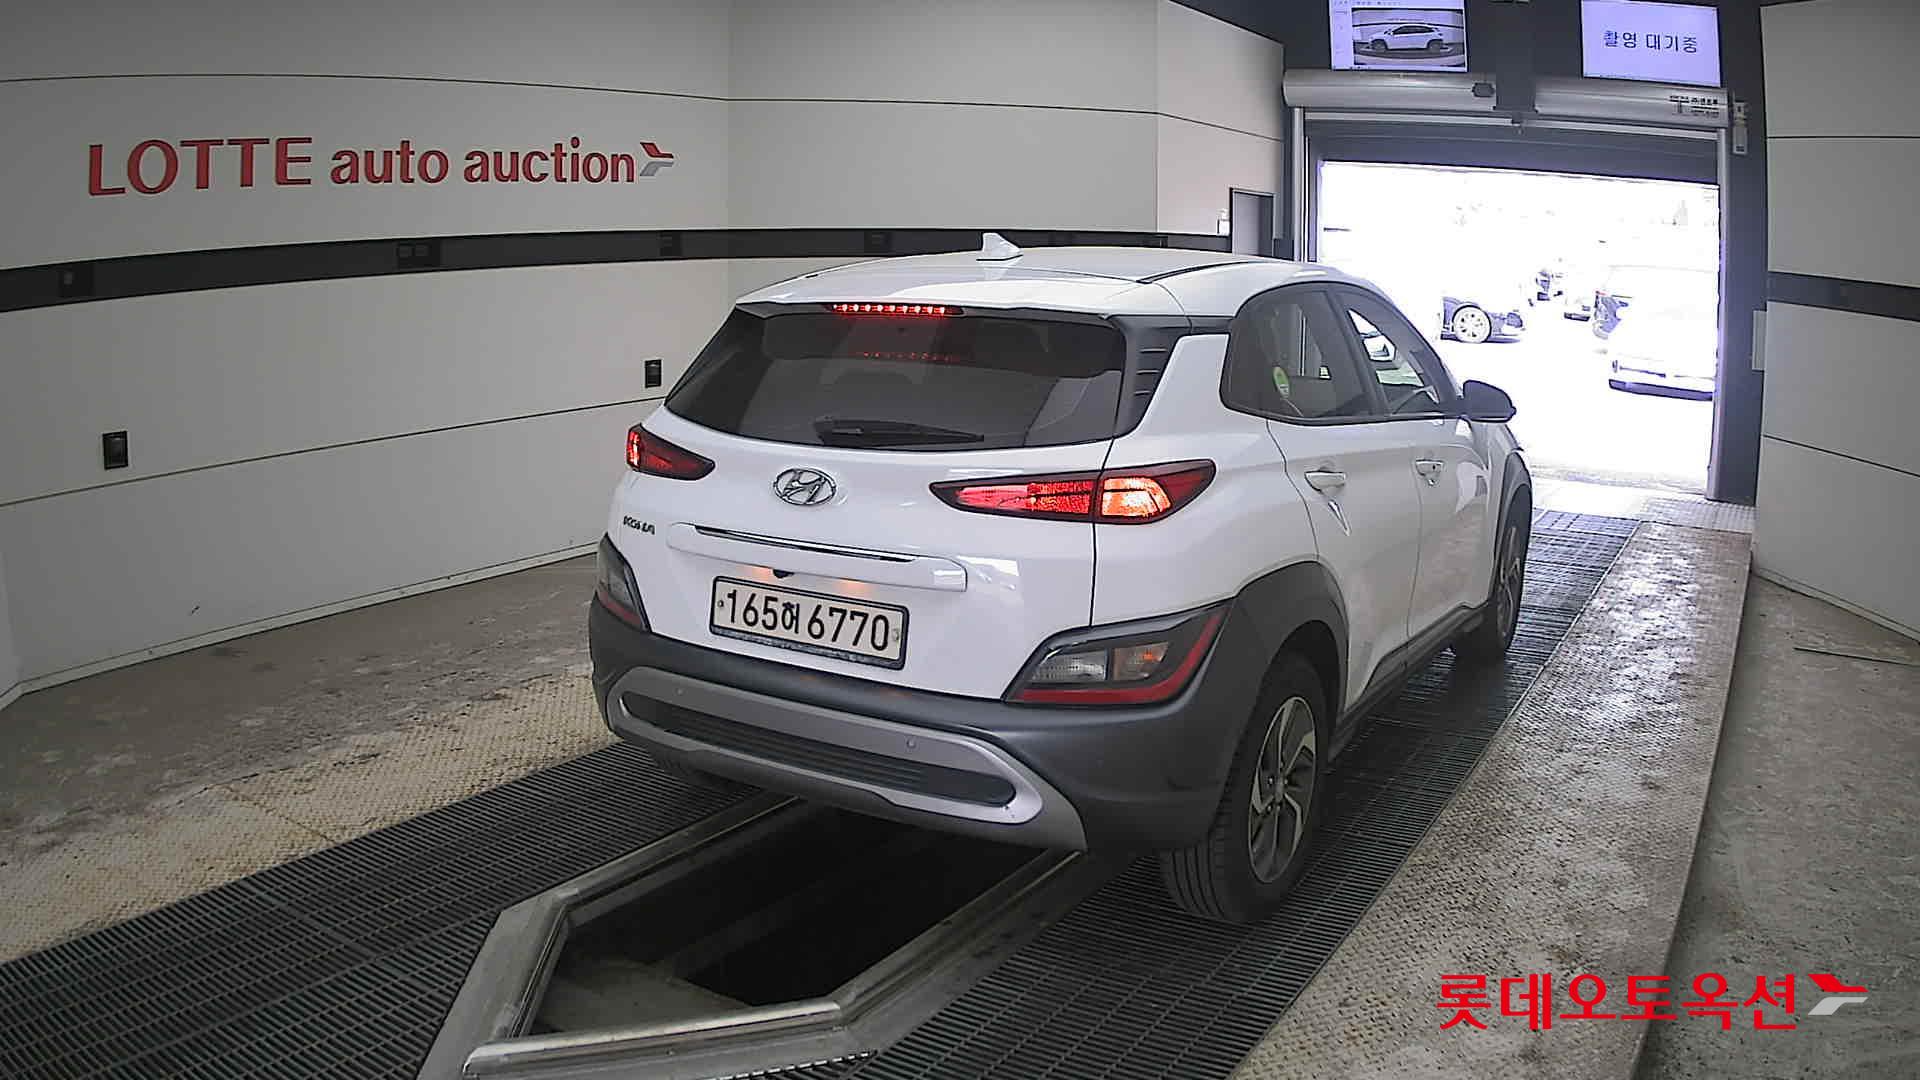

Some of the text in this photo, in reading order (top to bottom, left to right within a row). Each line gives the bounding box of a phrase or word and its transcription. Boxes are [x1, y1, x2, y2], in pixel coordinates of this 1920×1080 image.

[1645, 33, 1697, 54] 대기중
[87, 136, 637, 196] LOTTE auto auction
